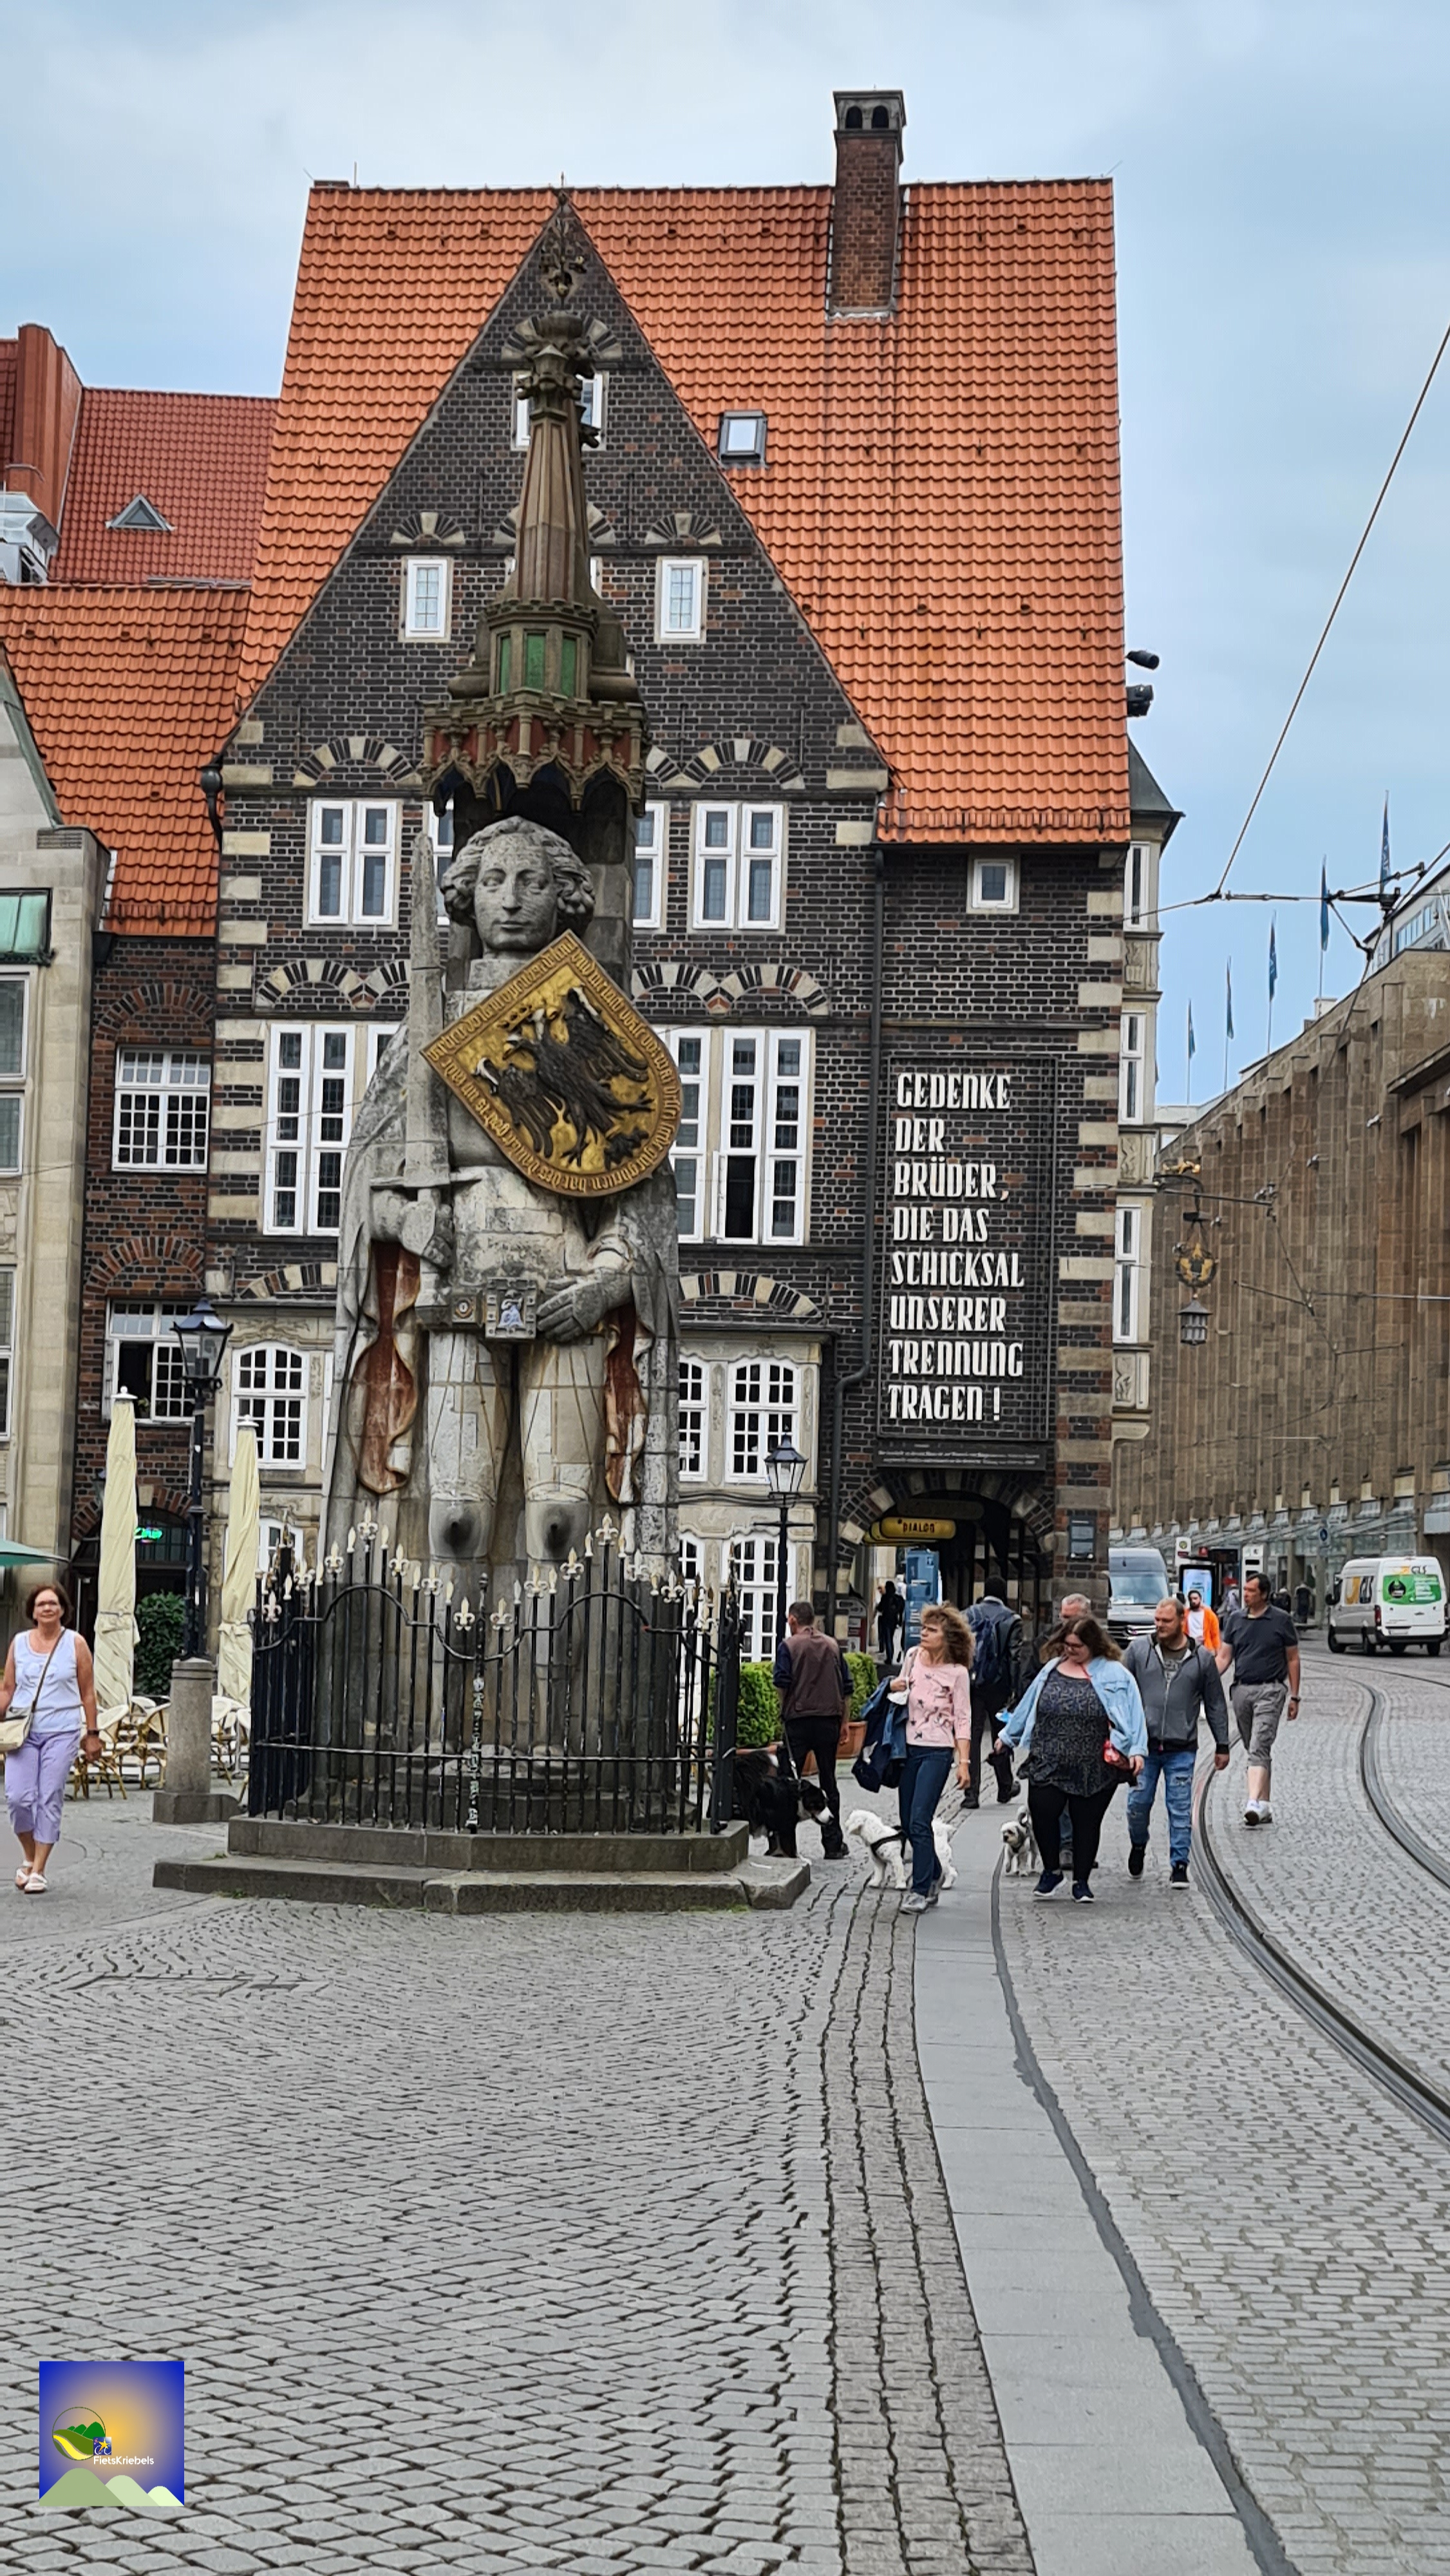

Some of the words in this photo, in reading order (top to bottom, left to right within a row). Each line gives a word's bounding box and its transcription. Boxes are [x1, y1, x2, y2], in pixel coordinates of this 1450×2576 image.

[897, 1072, 1011, 1109] GEDENKE
[895, 1117, 945, 1152] DER
[894, 1156, 1009, 1200] BRÜDER,
[893, 1206, 934, 1241] DIE
[943, 1208, 989, 1242] DAS
[891, 1251, 1024, 1287] SCHICKSAL
[890, 1296, 1006, 1331] UNSERER
[889, 1340, 1023, 1376] TRENNUNG
